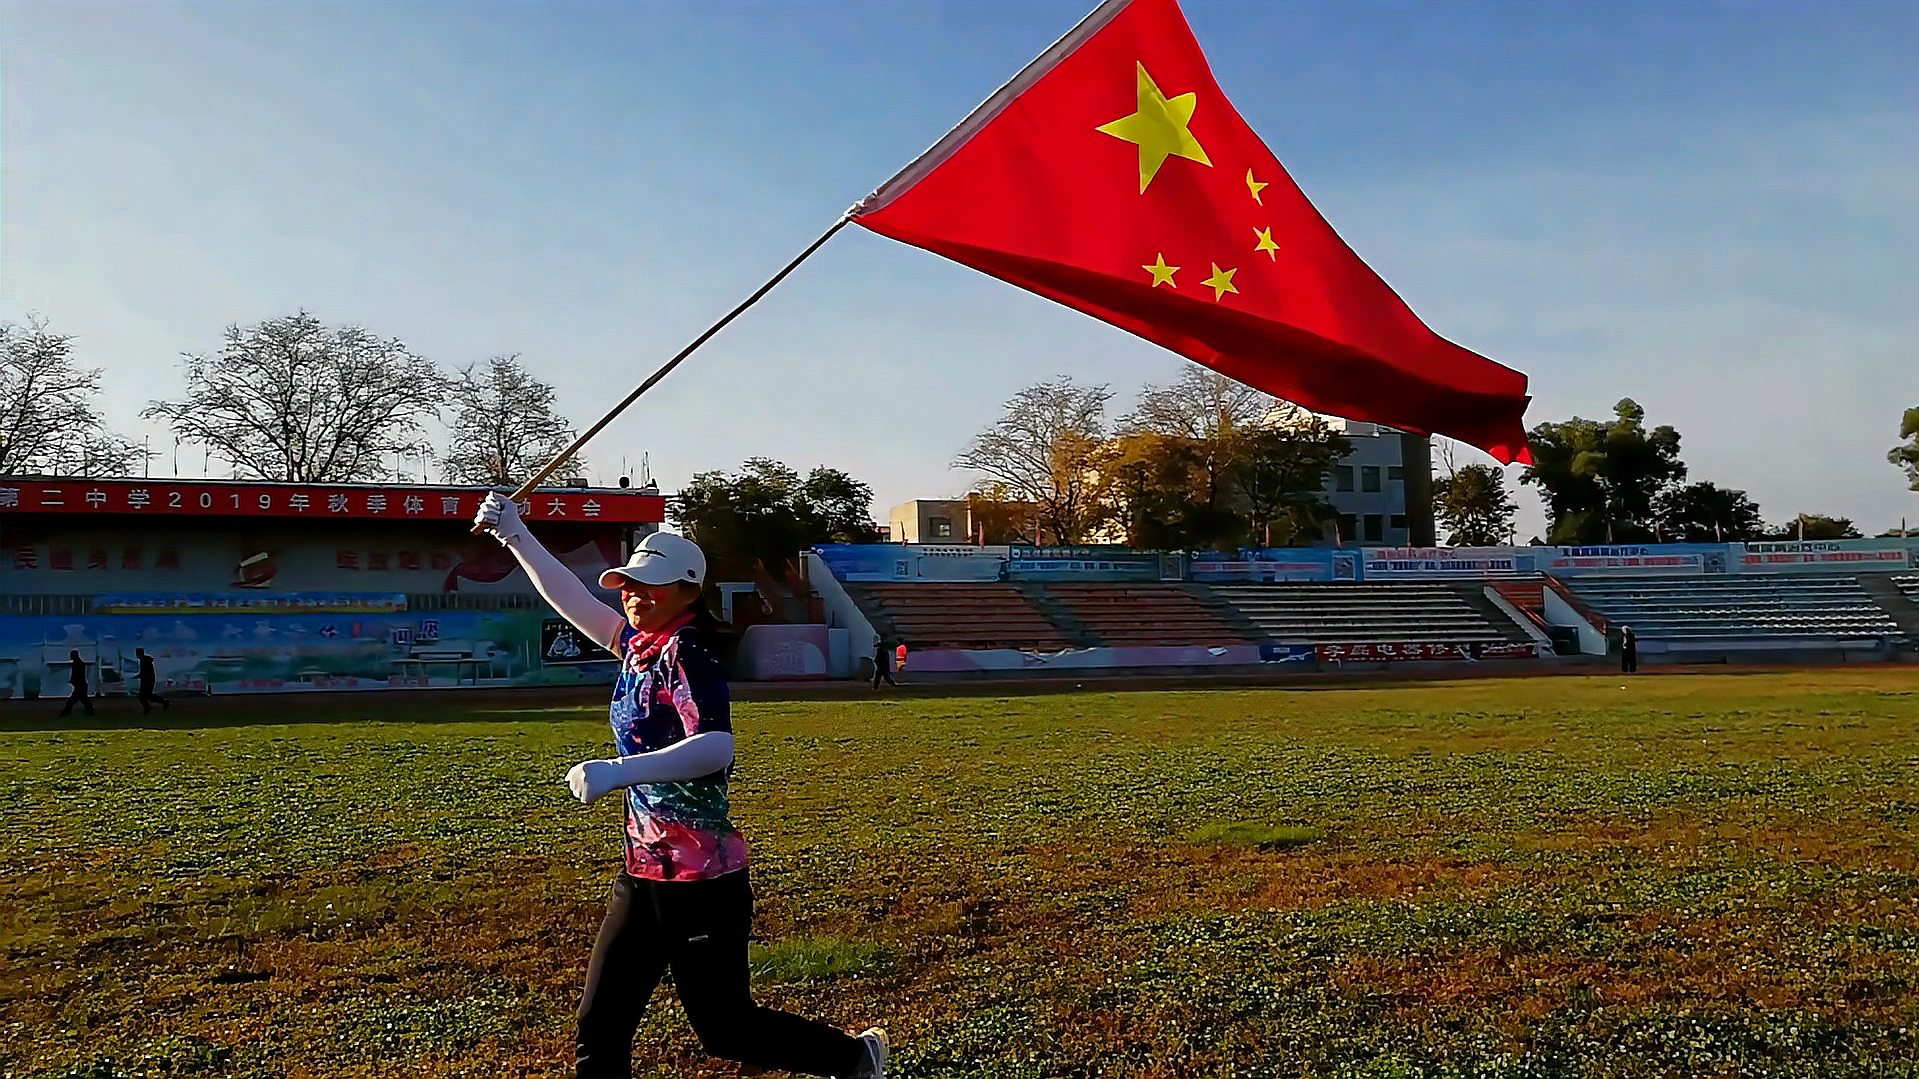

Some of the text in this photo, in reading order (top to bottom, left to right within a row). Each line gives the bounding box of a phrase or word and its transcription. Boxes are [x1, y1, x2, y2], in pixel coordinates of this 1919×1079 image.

[0, 487, 602, 518] 第二中学2019年秋季体育动大会
